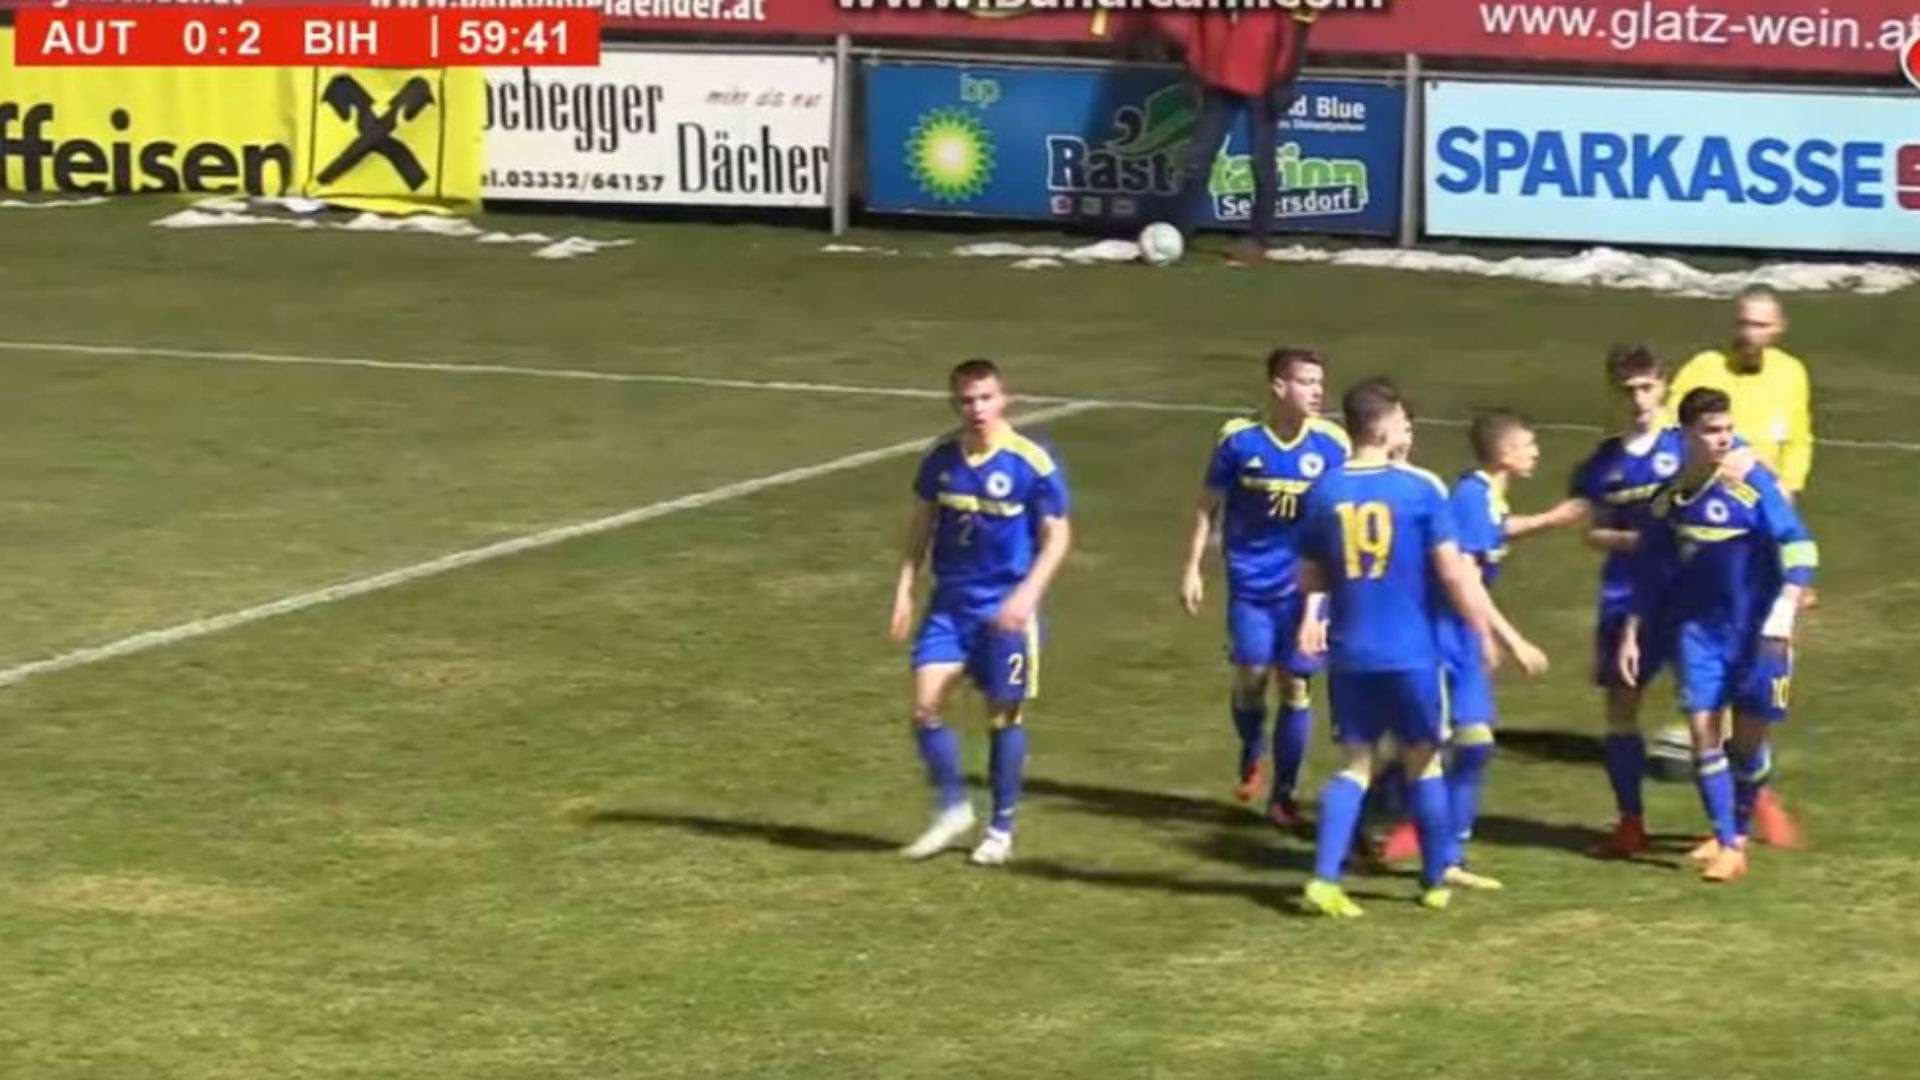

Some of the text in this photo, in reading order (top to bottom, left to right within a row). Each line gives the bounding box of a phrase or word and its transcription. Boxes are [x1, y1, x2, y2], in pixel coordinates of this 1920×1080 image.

[959, 72, 1002, 109] bp
[1316, 95, 1367, 120] Blue
[677, 121, 830, 195] Dächer
[1435, 126, 1885, 209] SPARKASSE
[1221, 189, 1352, 217] Sersdorf
[1334, 501, 1393, 580] 19
[1007, 652, 1025, 686] 2
[1770, 675, 1791, 709] 10
